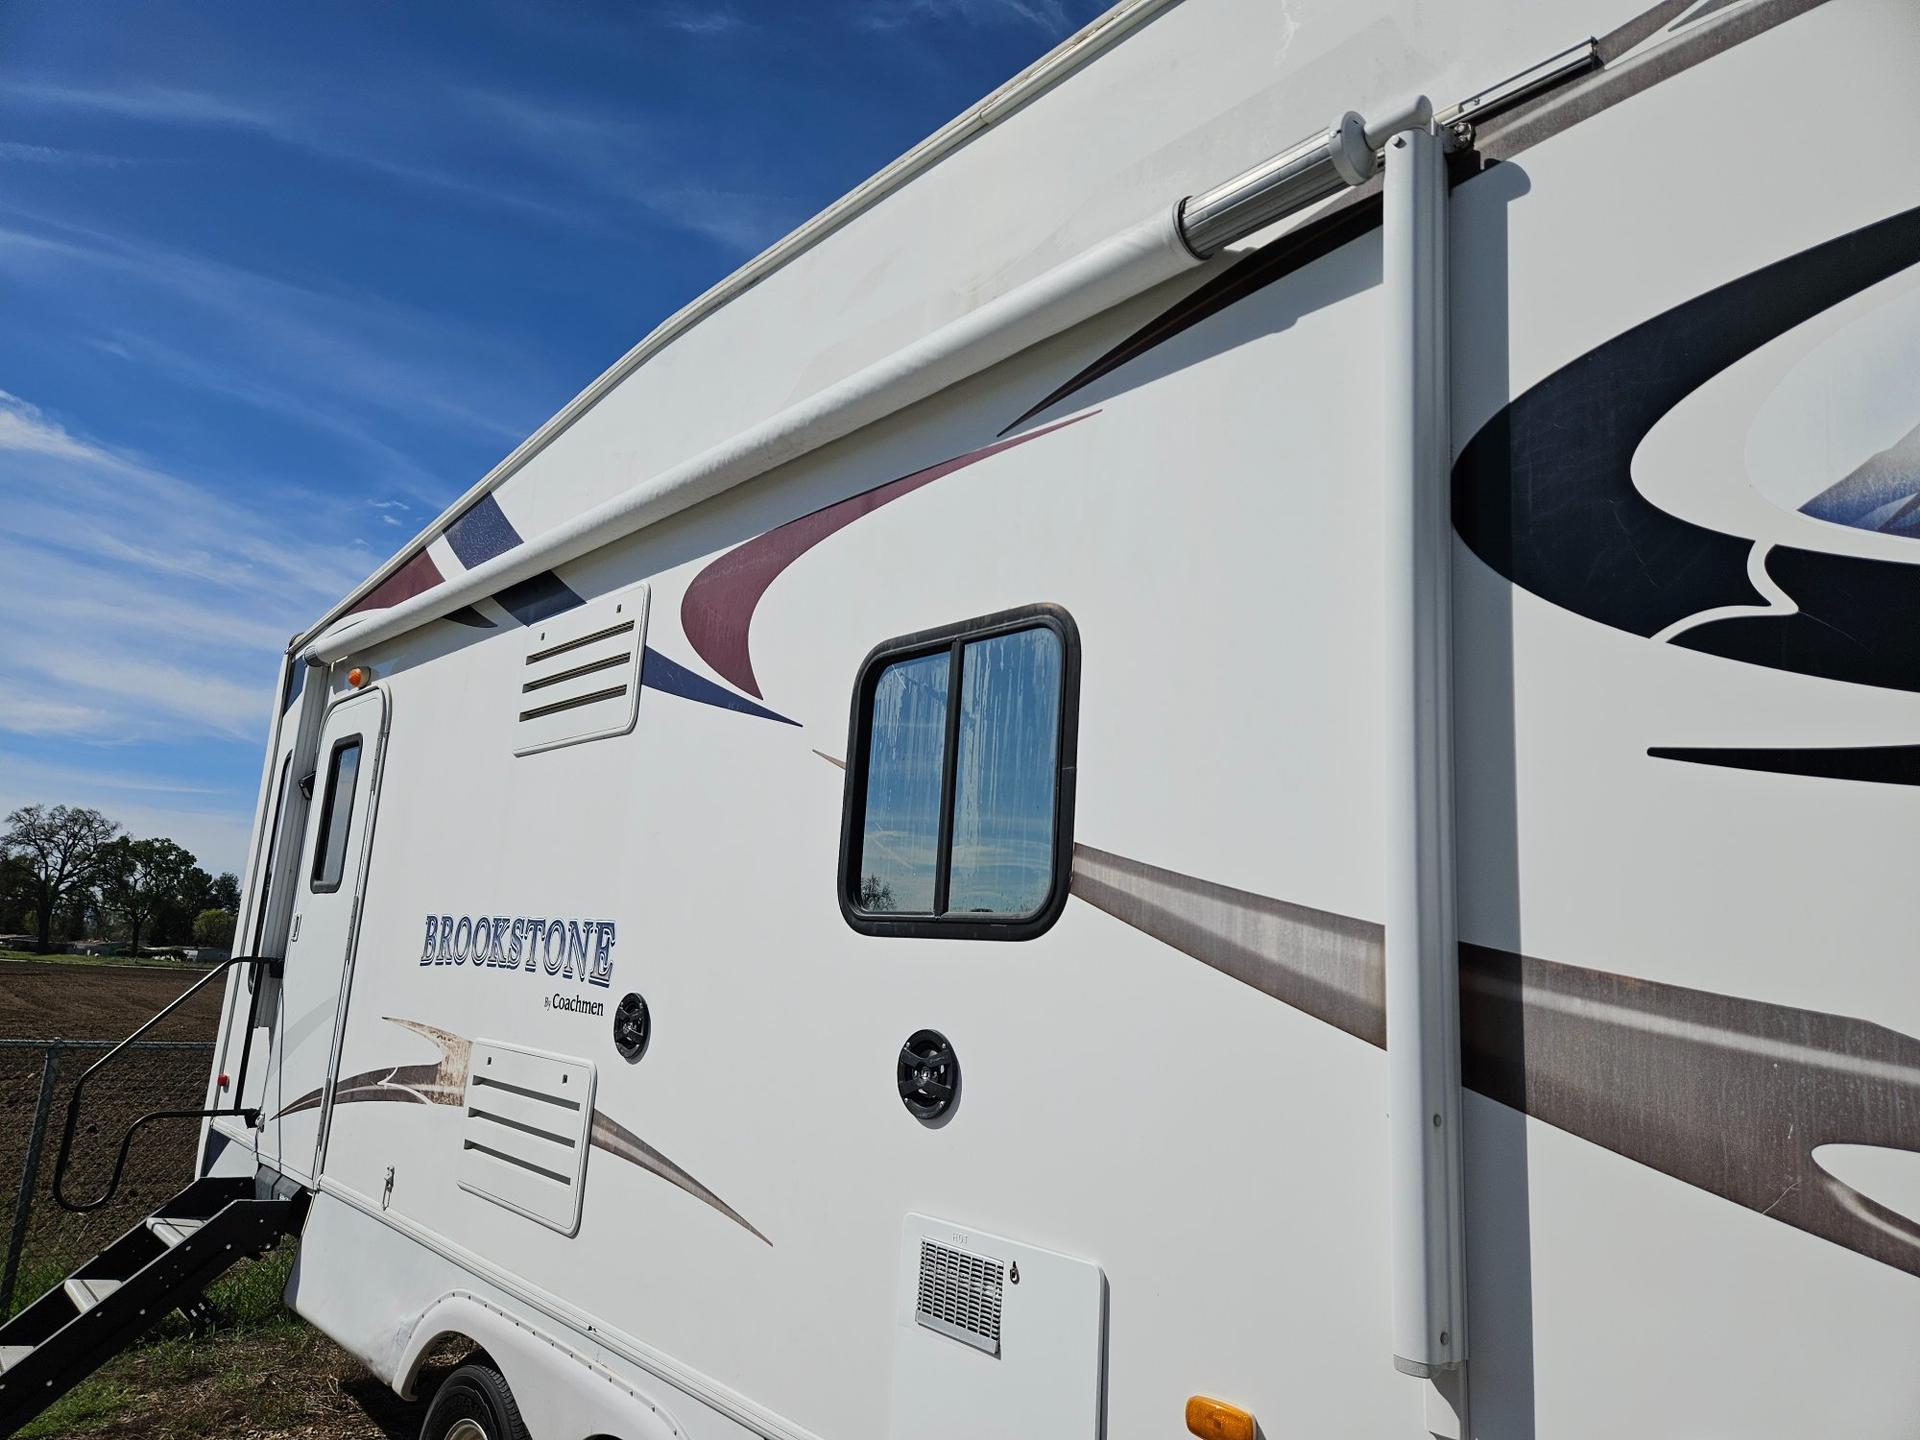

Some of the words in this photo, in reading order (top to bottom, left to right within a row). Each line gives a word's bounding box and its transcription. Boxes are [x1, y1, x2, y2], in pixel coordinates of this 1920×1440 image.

[420, 914, 615, 988] BROOKSTONE
[544, 996, 551, 1011] By
[552, 993, 604, 1016] Coachmen
